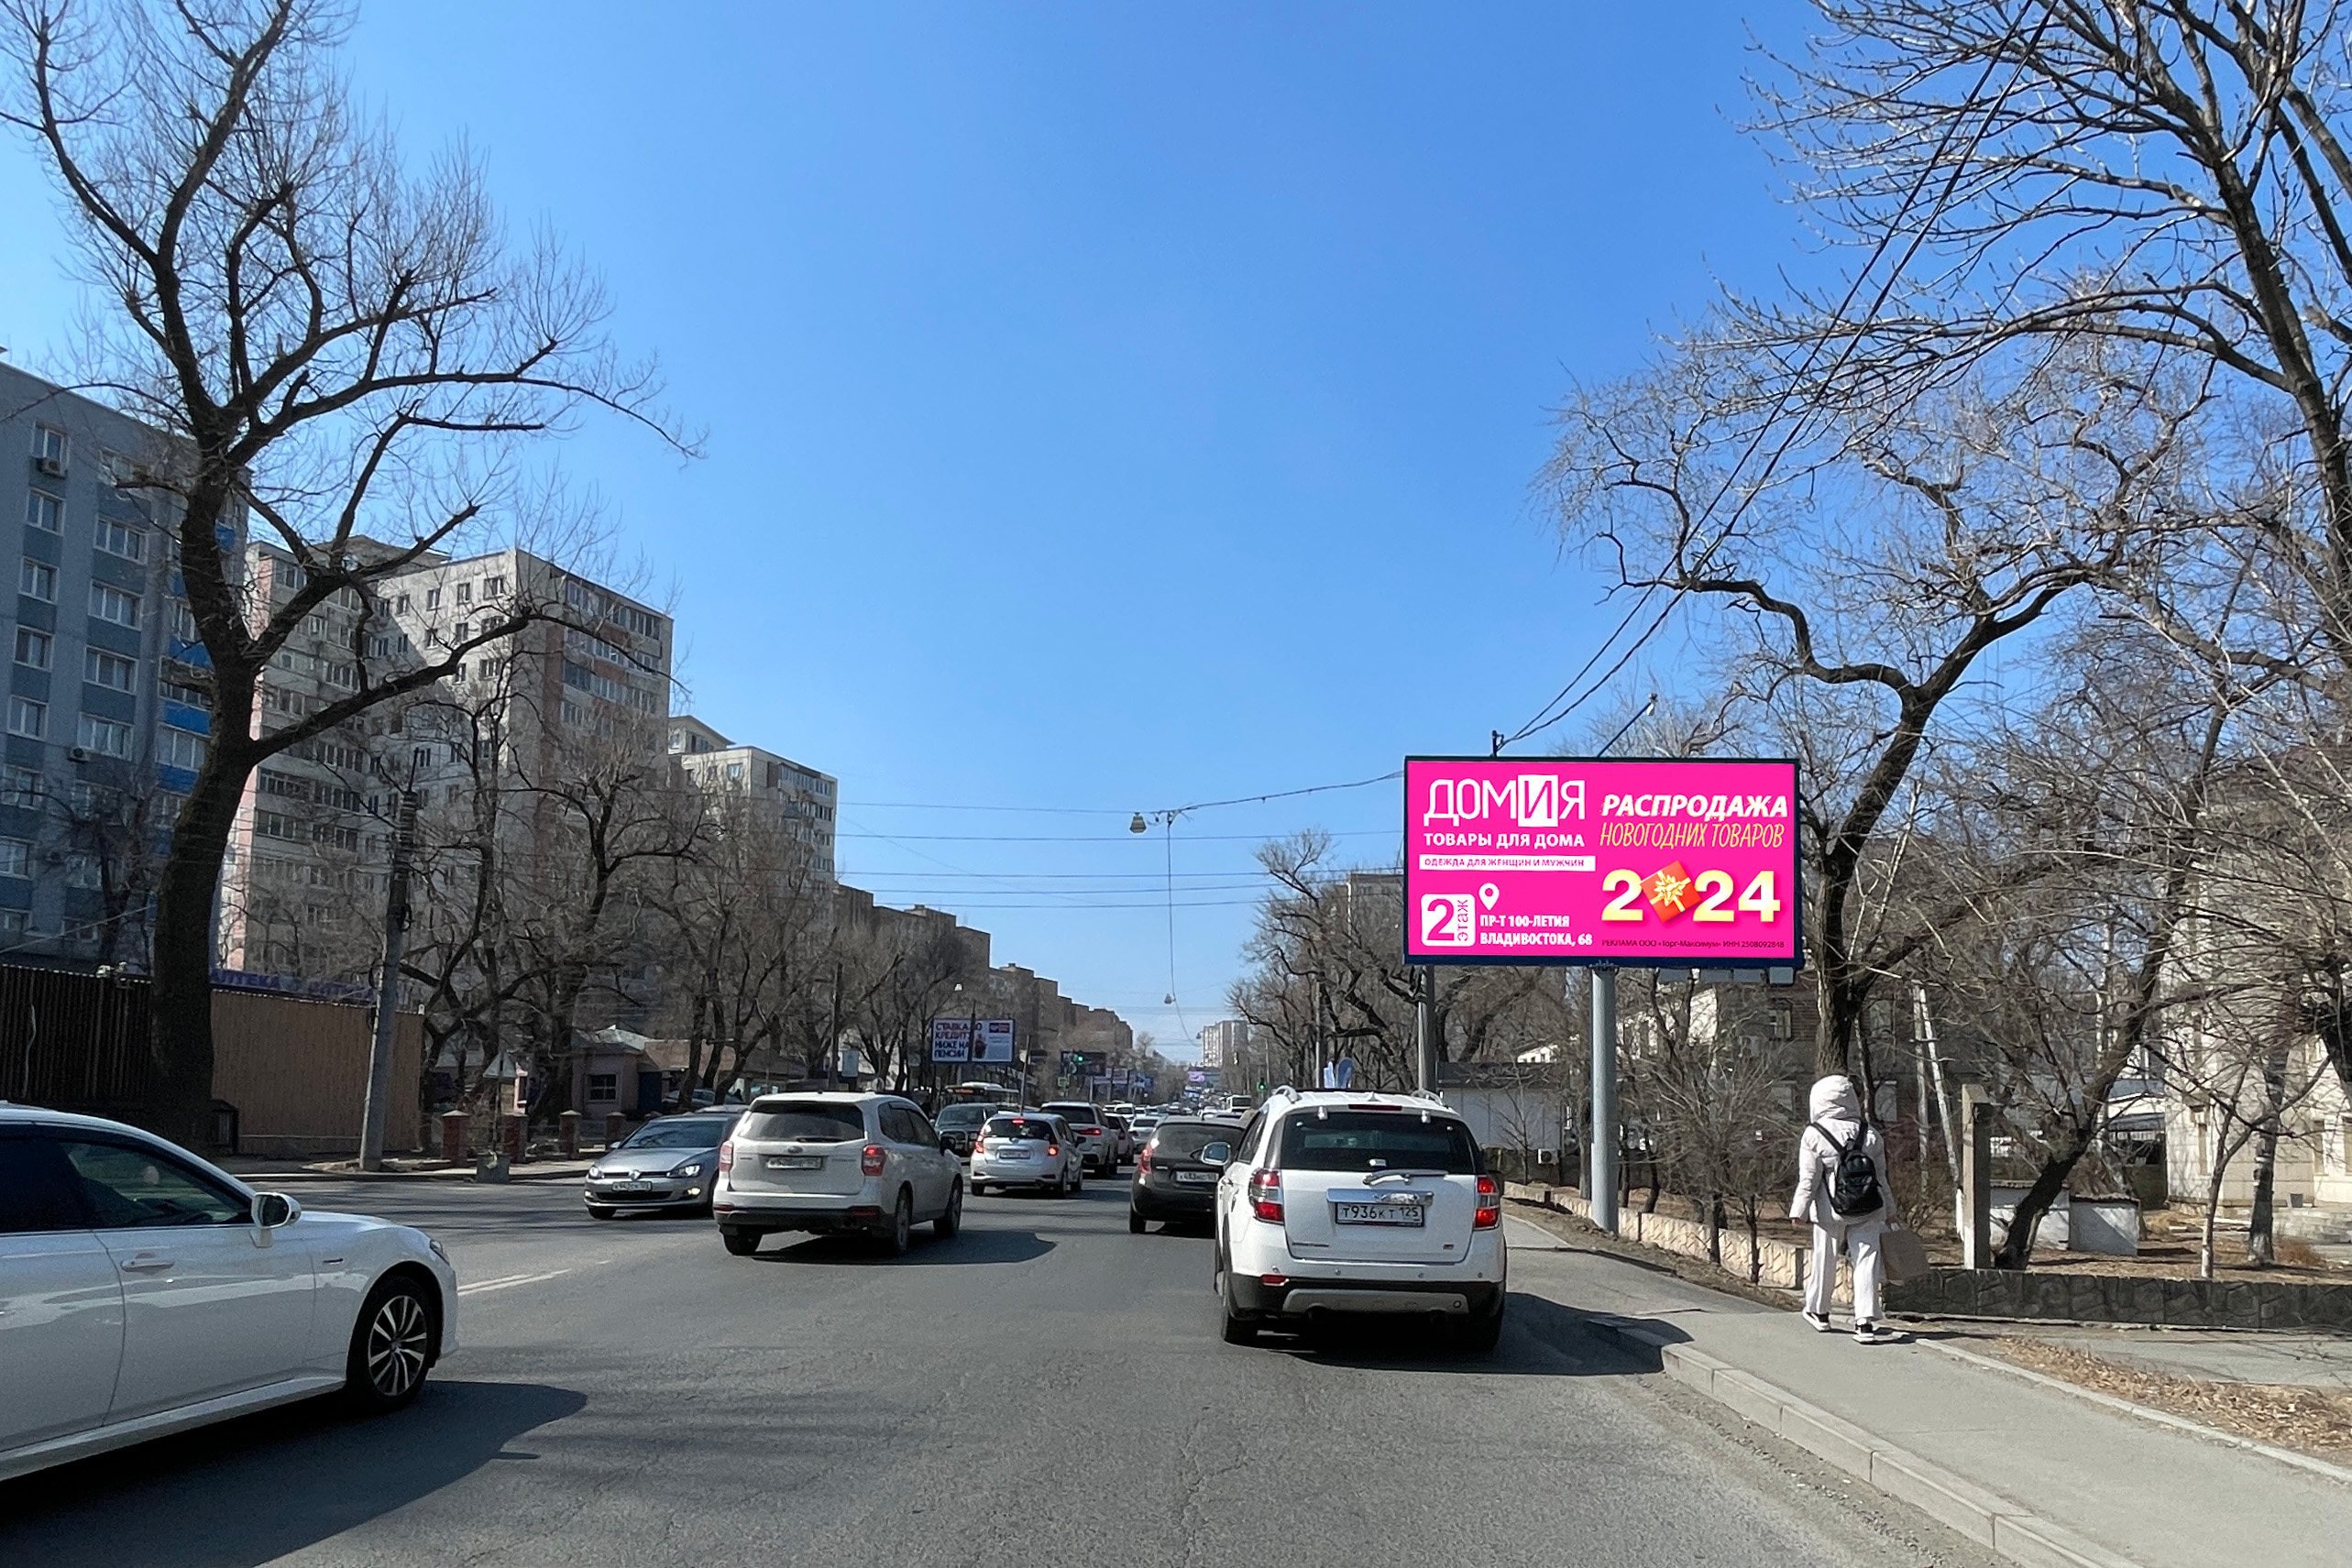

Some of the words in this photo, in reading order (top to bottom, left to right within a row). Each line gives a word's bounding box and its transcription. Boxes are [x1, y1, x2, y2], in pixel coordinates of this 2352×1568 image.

[1423, 774, 1586, 828] ДОМИЯ
[1601, 794, 1787, 821] РАСПРОДАЖА
[1423, 833, 1491, 847] ТОВАРЫ
[1496, 833, 1530, 849] ДЛЯ
[1534, 833, 1585, 850] ДОМА
[1599, 822, 1708, 850] НОВОГОДНИХ
[1711, 823, 1785, 848] ТОВАРОВ
[1424, 858, 1465, 867] ОДЕЖДА
[1467, 859, 1486, 868] ДЛЯ
[1488, 858, 1532, 868] ЖЕНЩИН
[1533, 859, 1540, 867] И
[1542, 859, 1585, 868] МУЖЧИН
[1426, 898, 1455, 941] 2
[1479, 915, 1506, 927] ПР-Т
[1508, 915, 1570, 927] 100-ЛЕТИЯ
[1479, 933, 1576, 947] ВЛАДИВОСТОКА,
[1577, 933, 1593, 946] 68
[1399, 1206, 1419, 1217] 125
